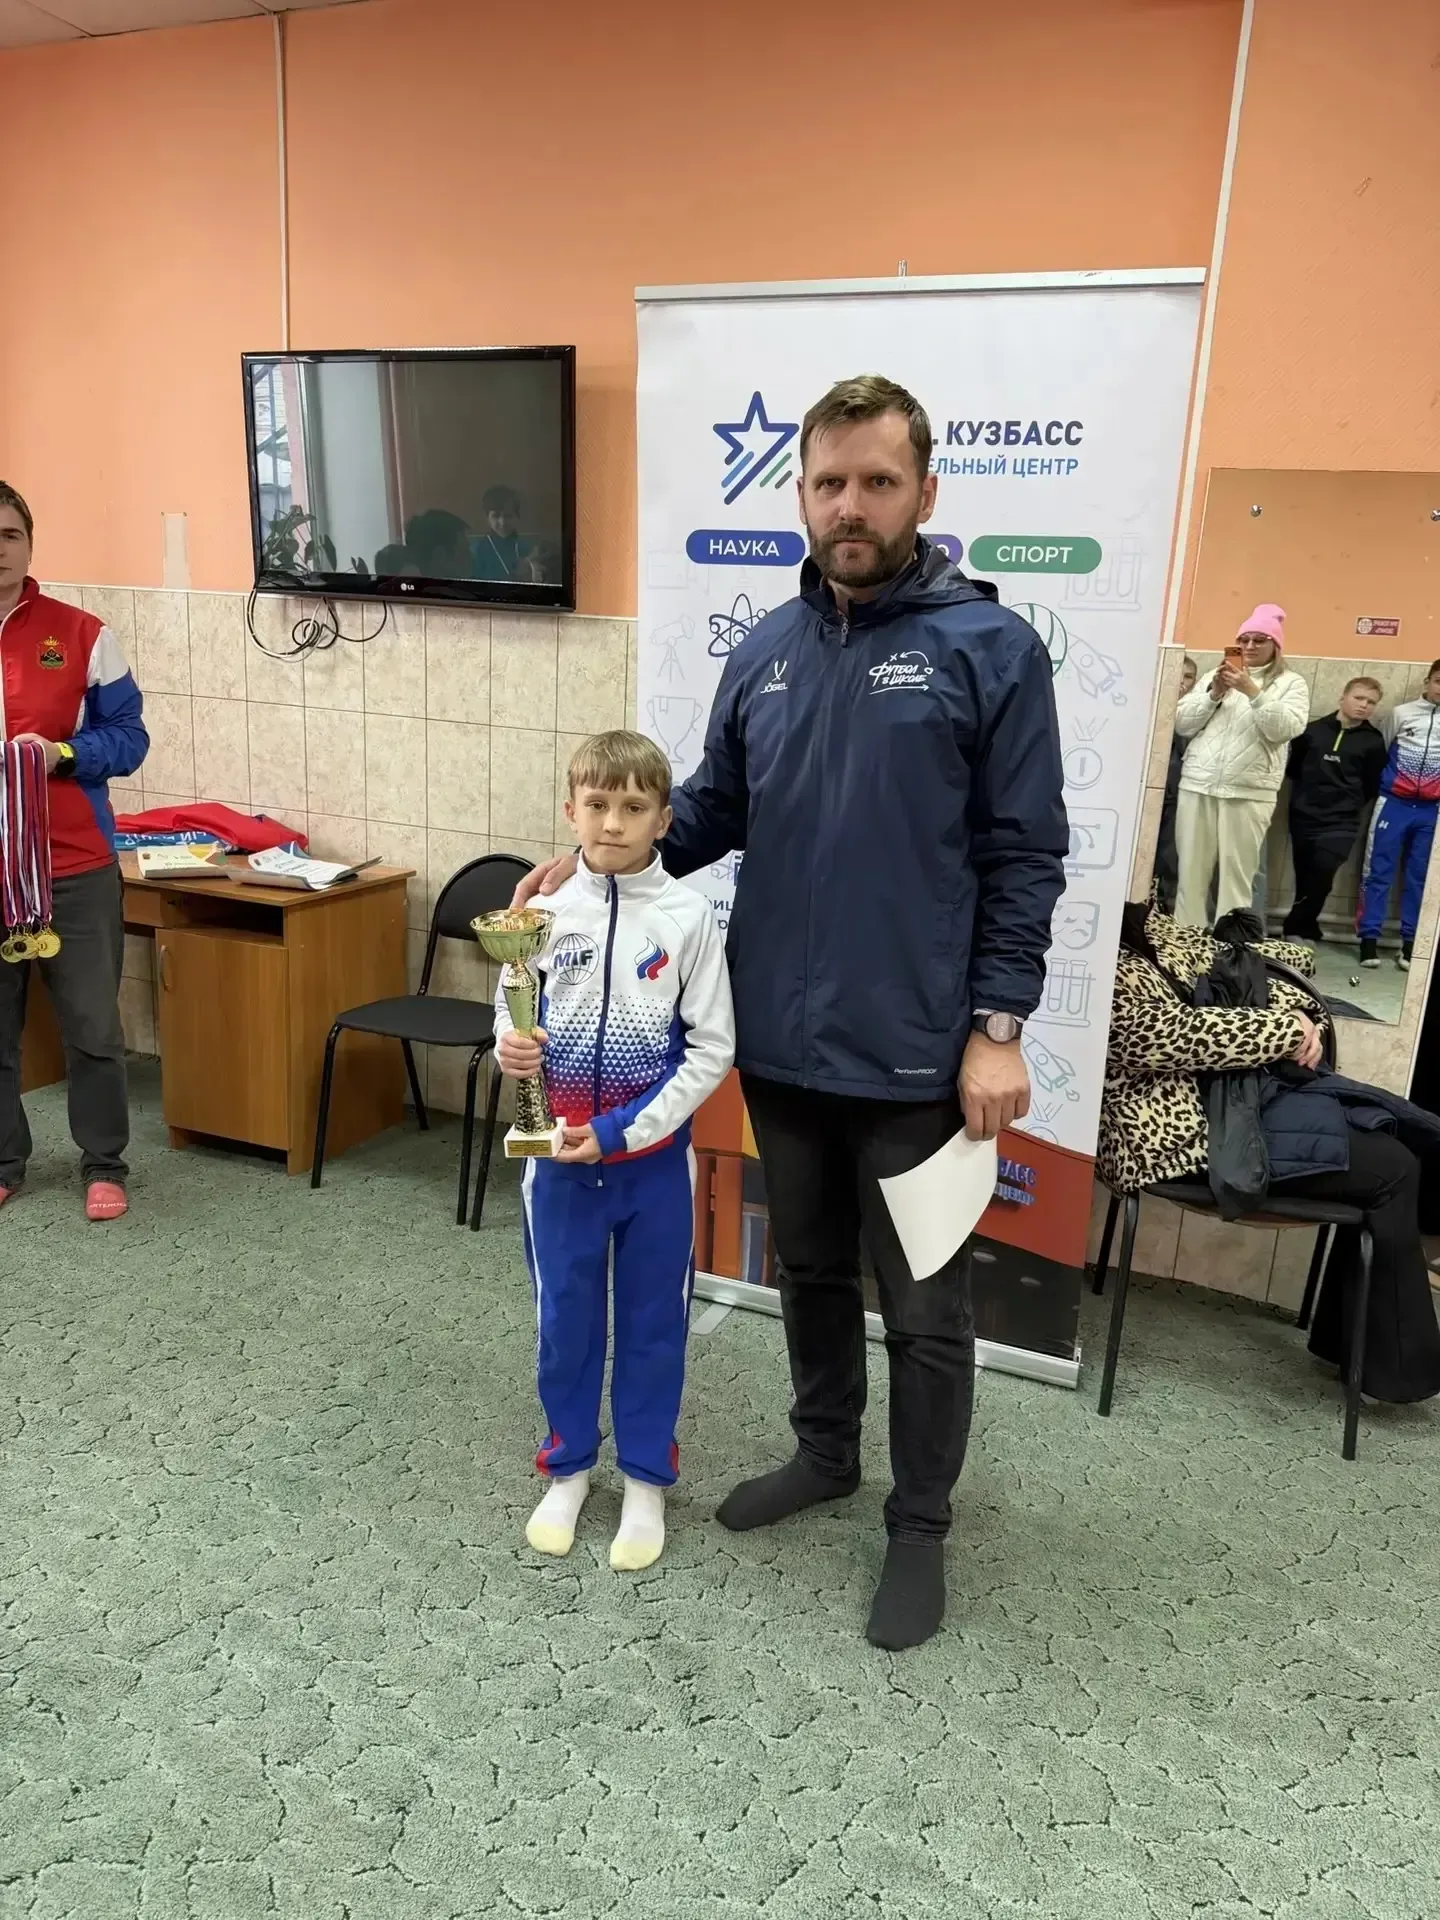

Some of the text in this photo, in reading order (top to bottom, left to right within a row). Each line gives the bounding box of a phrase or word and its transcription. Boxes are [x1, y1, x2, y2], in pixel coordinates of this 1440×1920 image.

[946, 420, 1084, 446] КУЗБАСС
[1012, 458, 1079, 478] ЦЕНТР
[709, 539, 780, 556] НАУКА
[996, 546, 1073, 564] СПОРТ
[760, 682, 788, 694] JÖGEL
[553, 949, 593, 969] MIF
